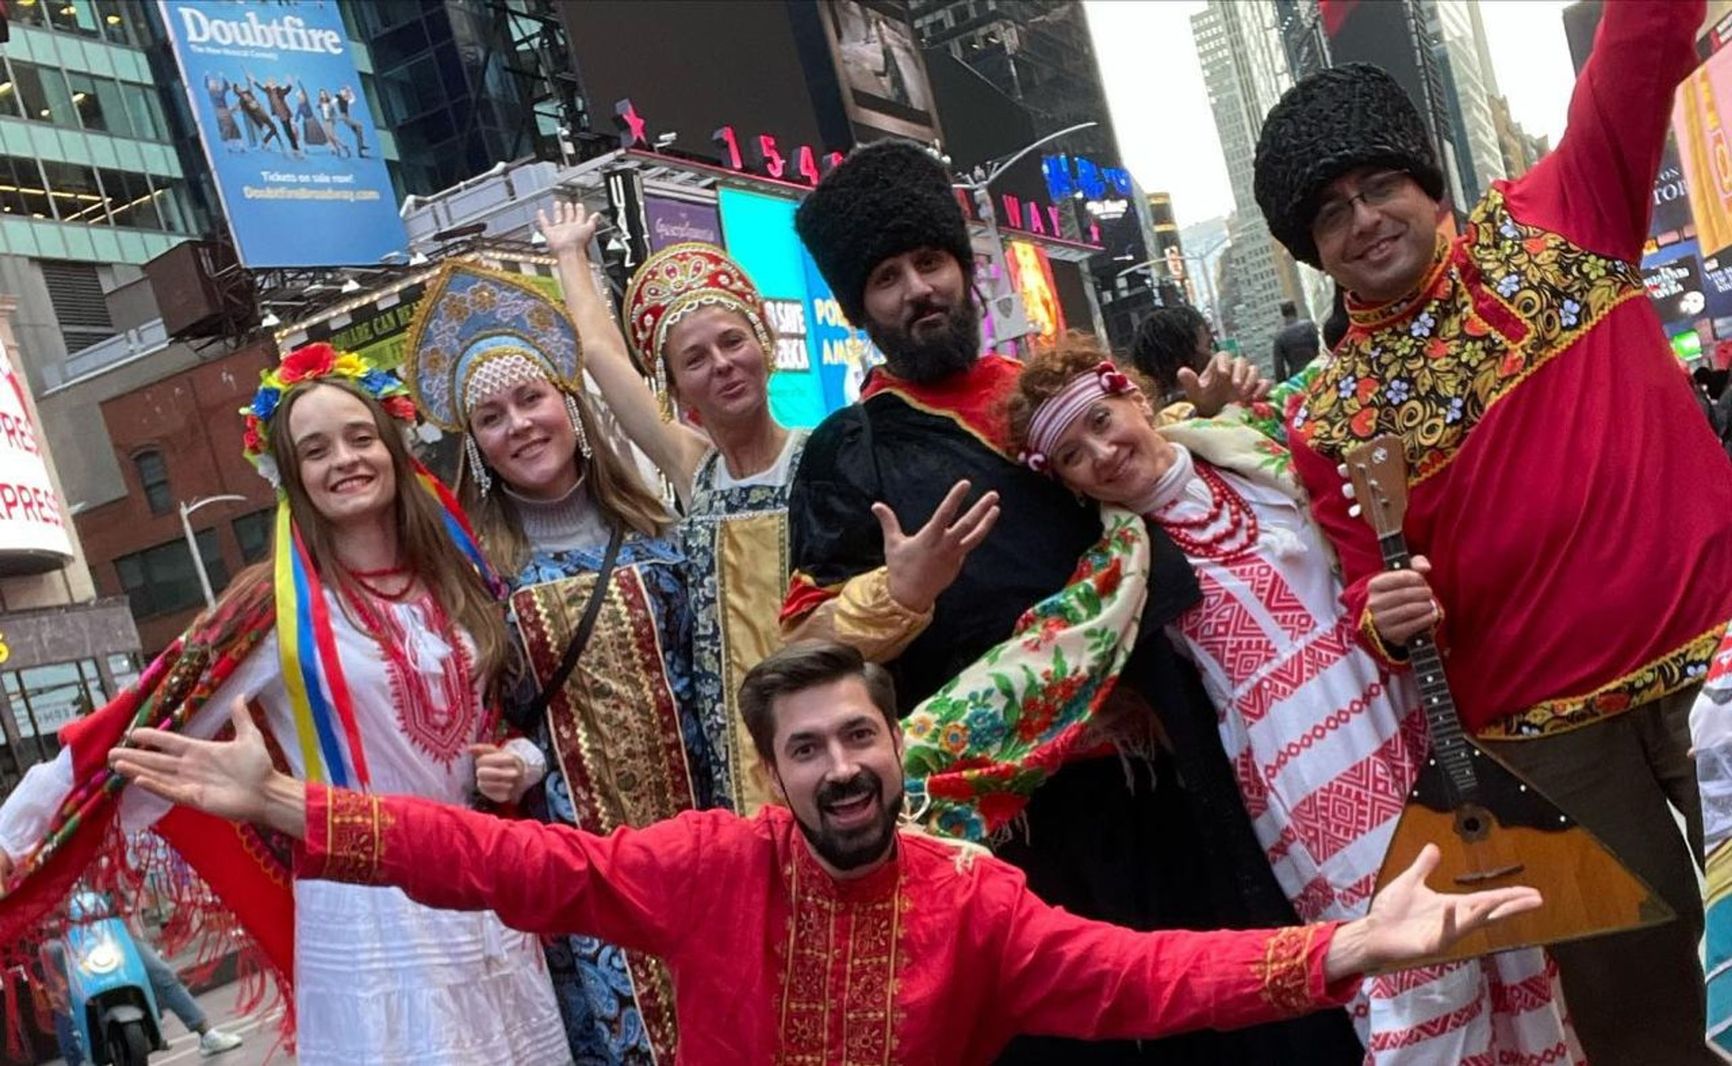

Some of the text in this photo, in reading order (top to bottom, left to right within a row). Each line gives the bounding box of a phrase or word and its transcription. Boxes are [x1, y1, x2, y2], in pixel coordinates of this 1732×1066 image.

[178, 7, 343, 54] Doubtfire
[261, 171, 296, 182] Tickets
[298, 174, 310, 183] on
[312, 173, 331, 183] sale
